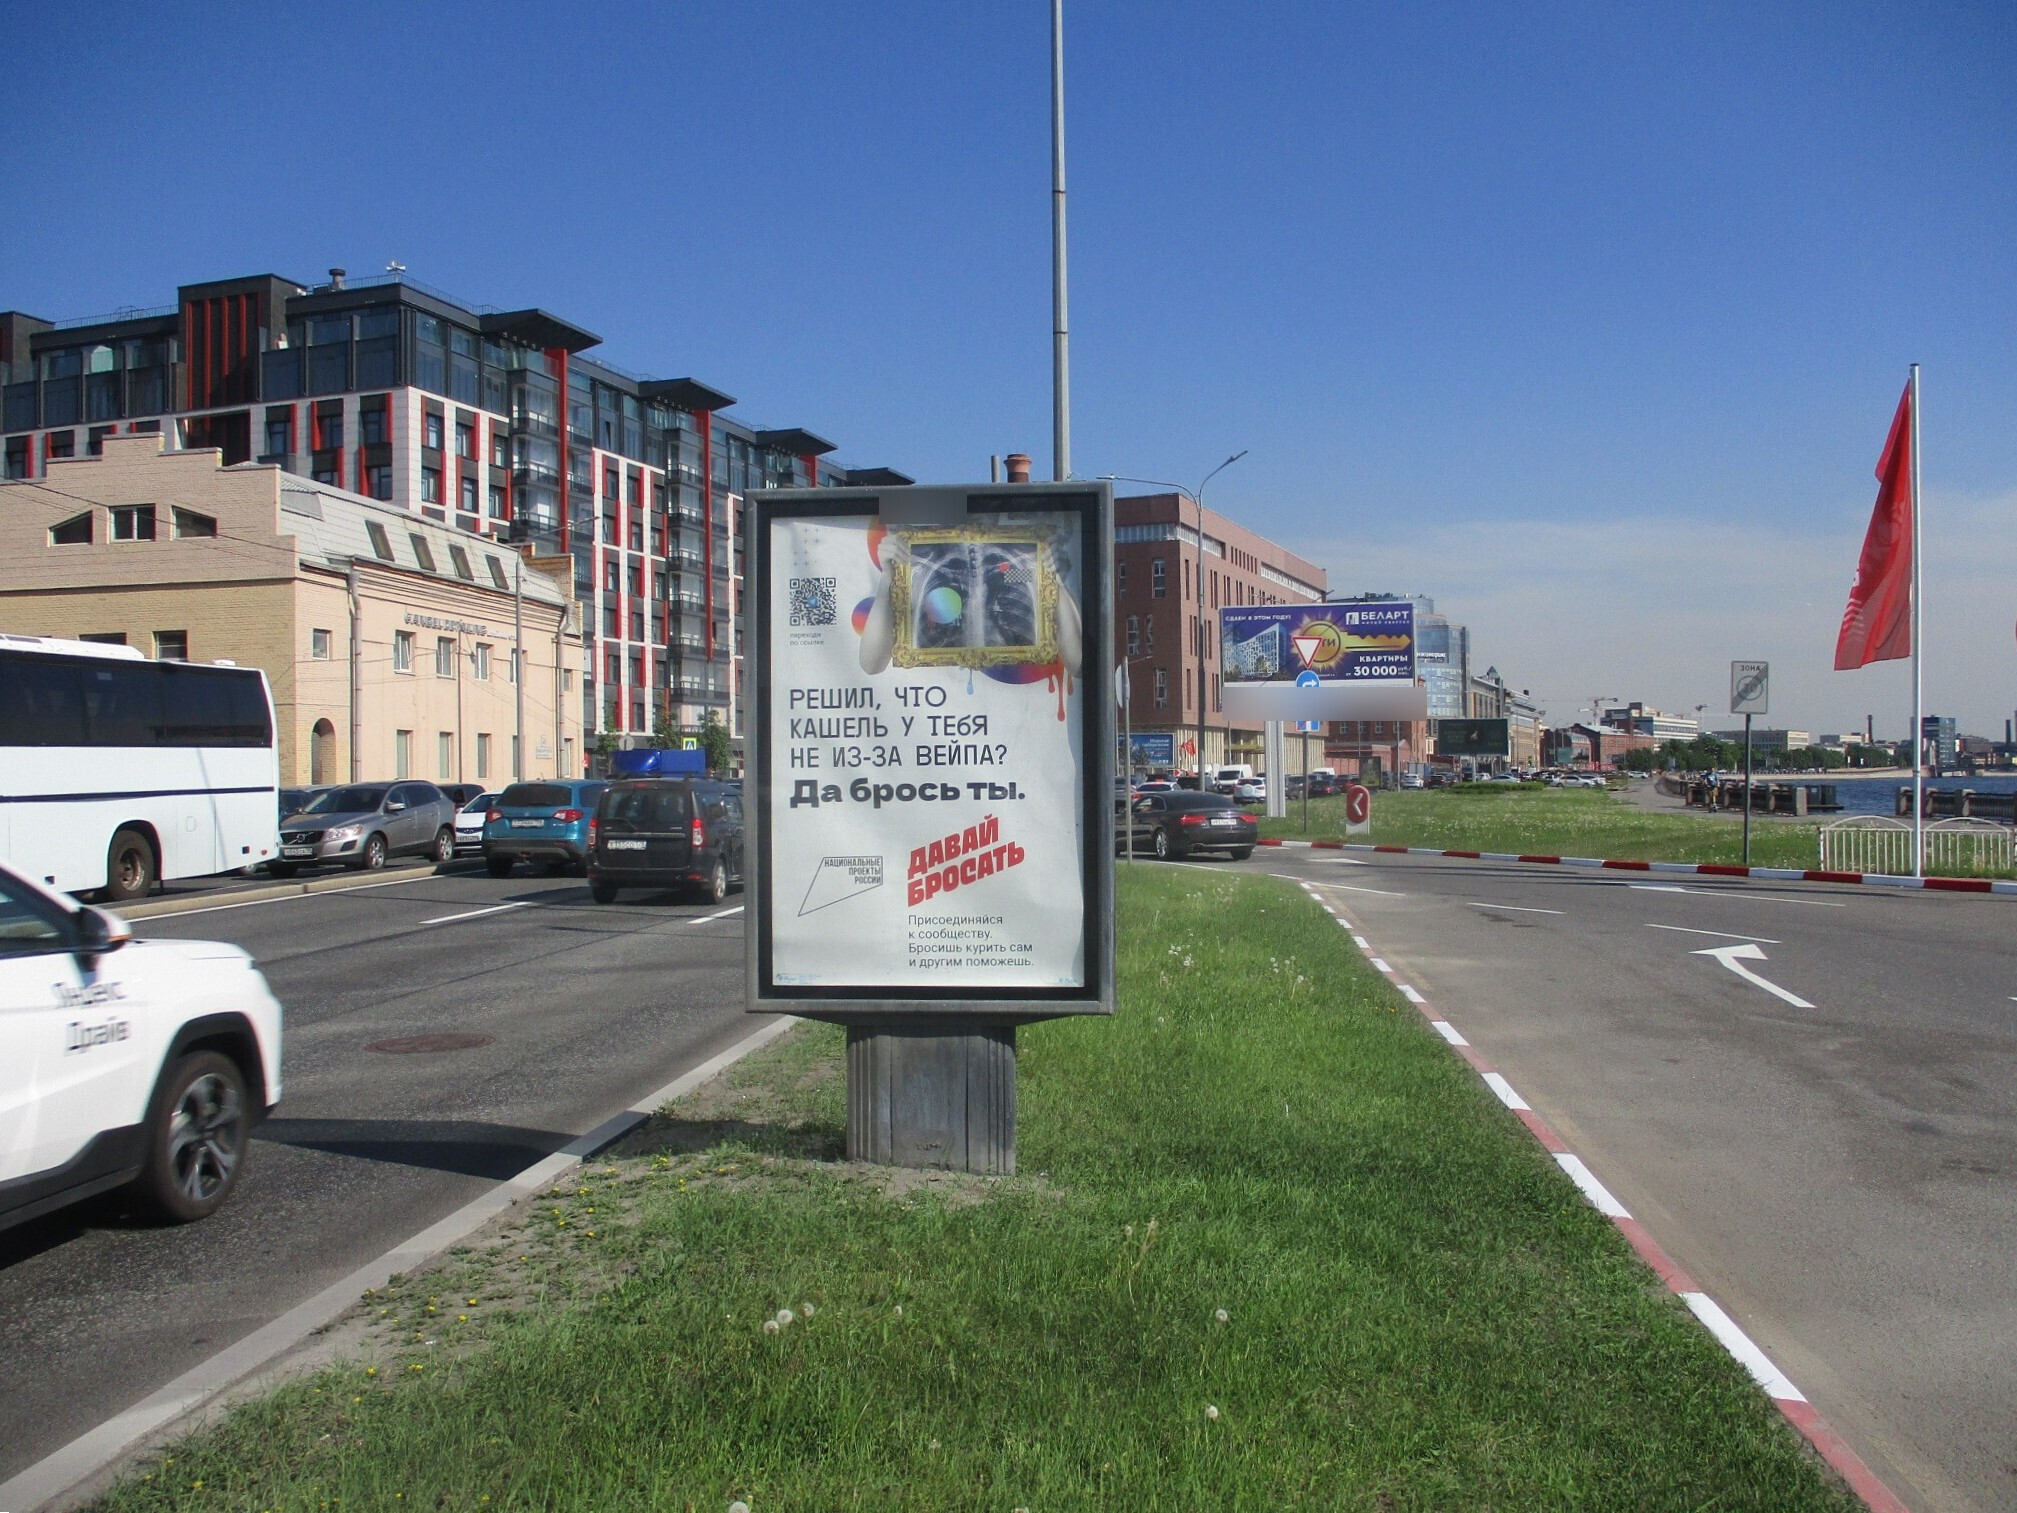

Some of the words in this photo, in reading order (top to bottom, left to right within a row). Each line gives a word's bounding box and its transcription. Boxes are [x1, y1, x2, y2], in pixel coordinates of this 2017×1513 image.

[1361, 611, 1410, 620] БЕЛАРТ
[1354, 666, 1370, 676] 30
[1372, 666, 1397, 676] 000
[790, 687, 881, 710] РЕШИЛ,
[895, 686, 947, 707] ЧТО
[790, 716, 888, 739] КАШЕЛЬ
[901, 716, 914, 736] У
[790, 747, 819, 768] НЕ
[833, 746, 902, 767] ИЗ-ЗА
[916, 739, 1008, 766] ВЕЙПА?
[790, 779, 843, 808] Да
[850, 777, 961, 808] брось
[967, 782, 1025, 800] ты.
[908, 813, 999, 880] ДАВАЙ
[824, 858, 881, 868] НАЦИОНАЛЬНЫЕ
[848, 867, 881, 876] ПРОЕКТЫ
[908, 841, 1025, 908] БРОСАТЬ
[854, 876, 881, 884] РОССИИ
[908, 914, 1003, 929] Присоединяйся
[908, 930, 915, 939] к
[918, 929, 993, 942] сообществу.
[908, 943, 963, 956] Бросишь
[966, 944, 1006, 956] курить
[1010, 944, 1033, 952] сам
[908, 958, 917, 967] и
[919, 957, 963, 969] другим
[966, 957, 1034, 967] поможешь.
